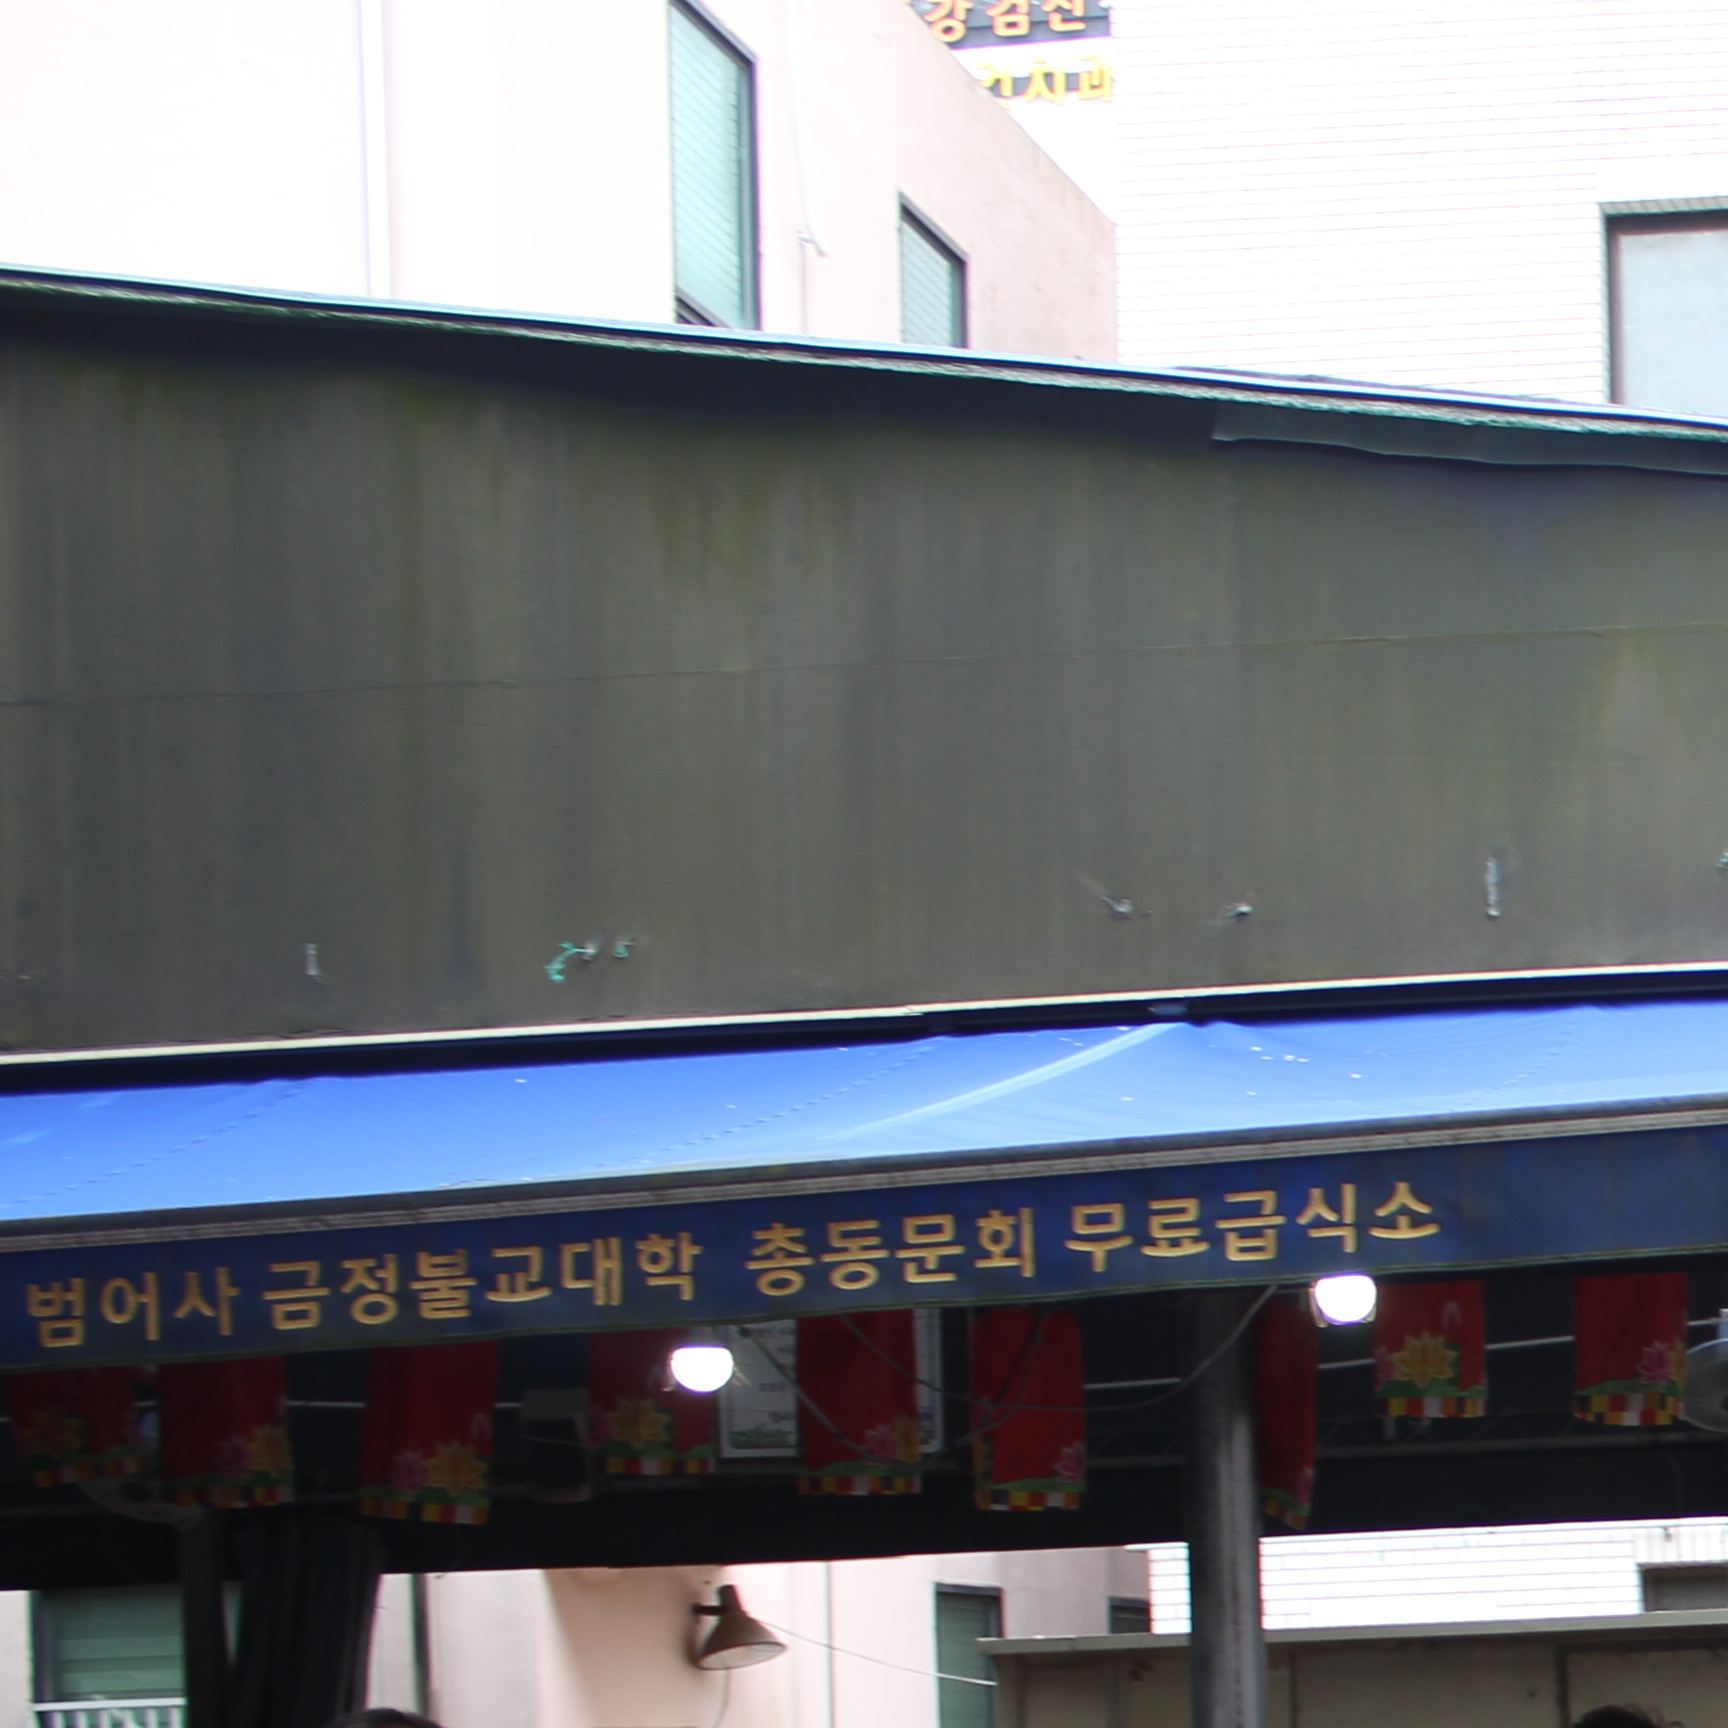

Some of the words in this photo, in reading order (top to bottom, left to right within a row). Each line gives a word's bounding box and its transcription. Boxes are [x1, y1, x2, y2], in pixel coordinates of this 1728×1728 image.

[27, 1266, 240, 1348] 범어사
[262, 1231, 704, 1330] 금정불교대학
[745, 1207, 1037, 1297] 총동문회
[1065, 1181, 1440, 1271] 무료급식소
